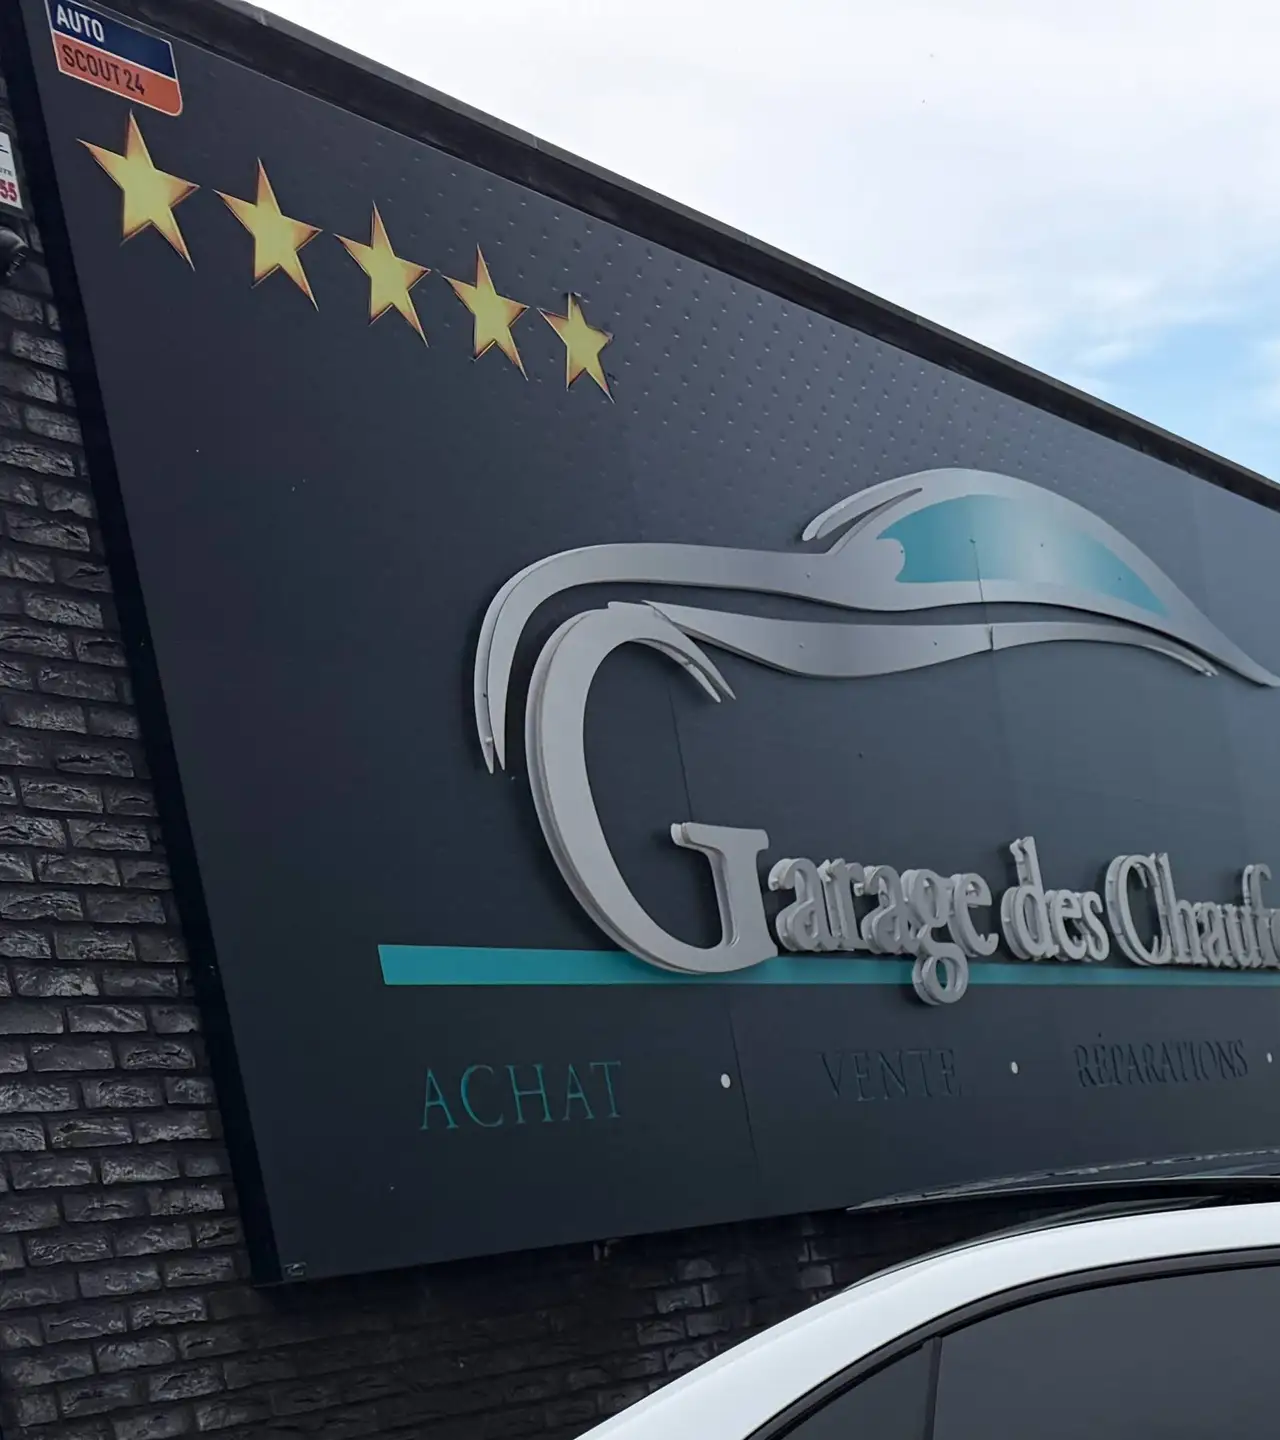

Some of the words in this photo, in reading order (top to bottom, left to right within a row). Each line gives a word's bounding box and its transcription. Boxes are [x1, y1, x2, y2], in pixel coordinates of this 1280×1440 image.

[57, 4, 105, 42] AUTO
[61, 44, 120, 85] SCOUT
[123, 69, 145, 95] 24
[525, 601, 999, 1005] Garage
[1001, 836, 1110, 961] des
[419, 1060, 622, 1130] ACHAT
[815, 1047, 962, 1103] VENTE
